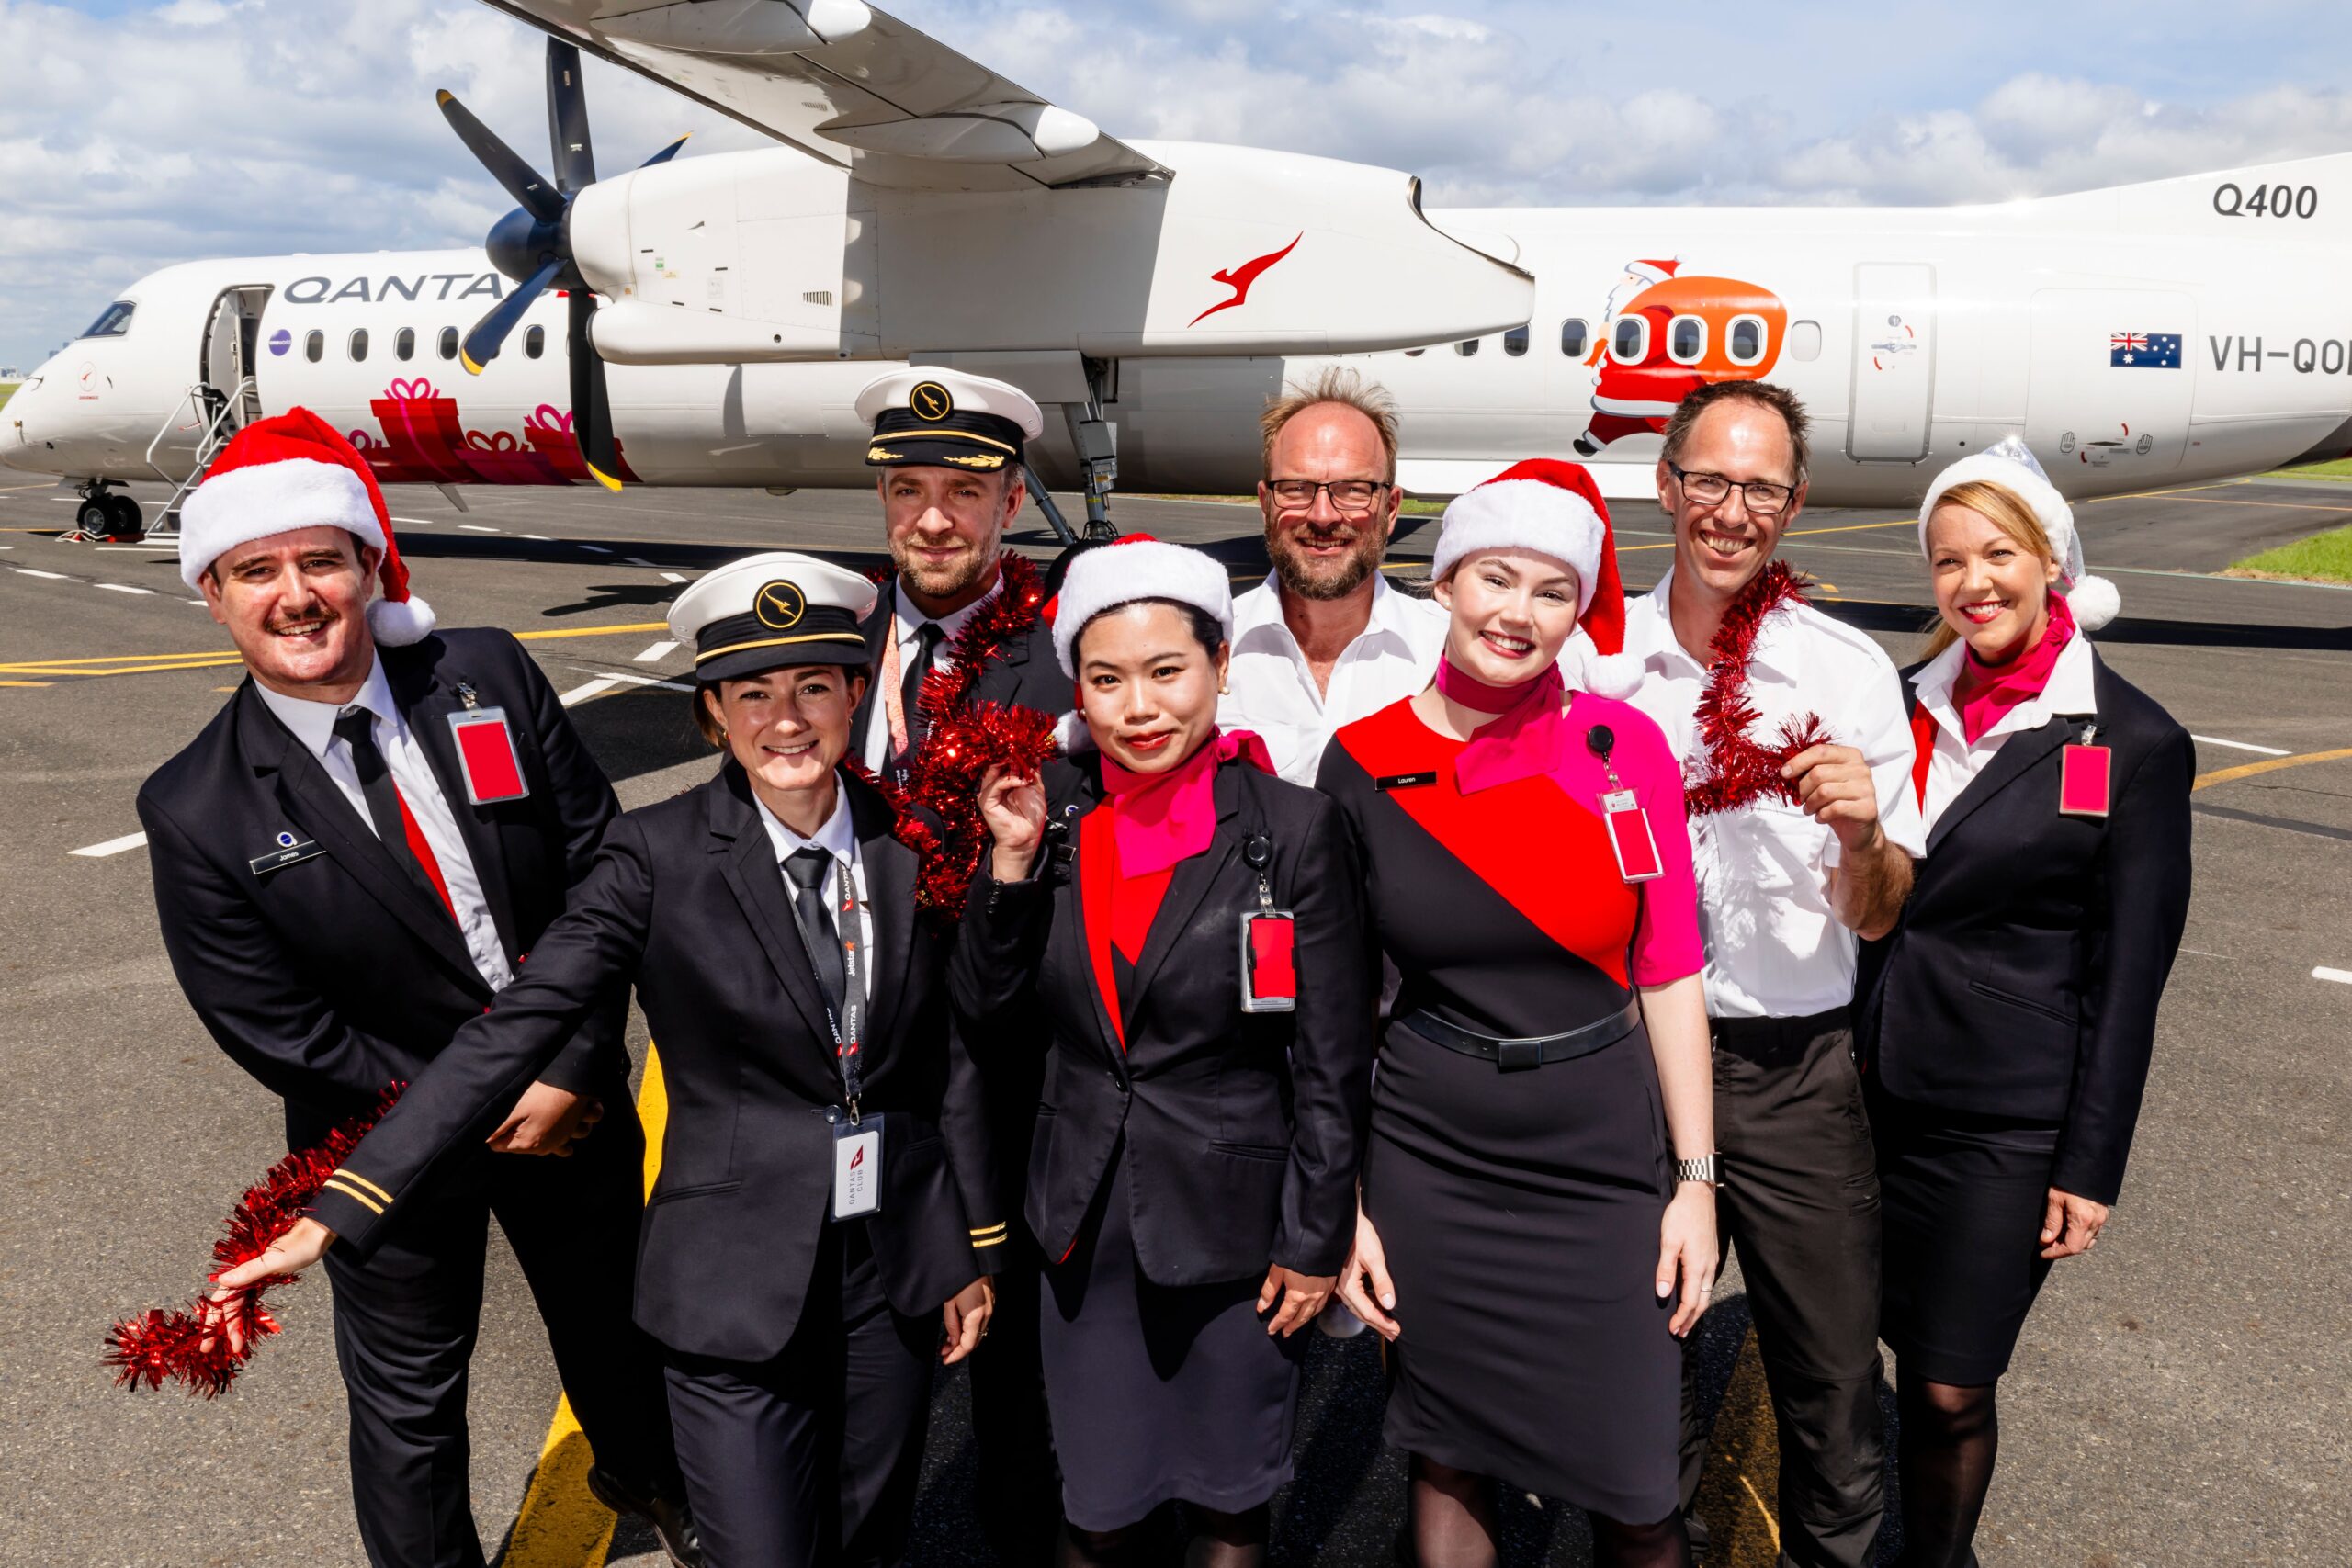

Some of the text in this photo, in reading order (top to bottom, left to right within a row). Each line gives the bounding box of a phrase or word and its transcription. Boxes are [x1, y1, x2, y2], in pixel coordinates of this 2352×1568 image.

[2213, 183, 2317, 219] Q400
[284, 273, 552, 304] QANTA
[2209, 335, 2352, 376] VH-QO
[279, 852, 300, 862] James
